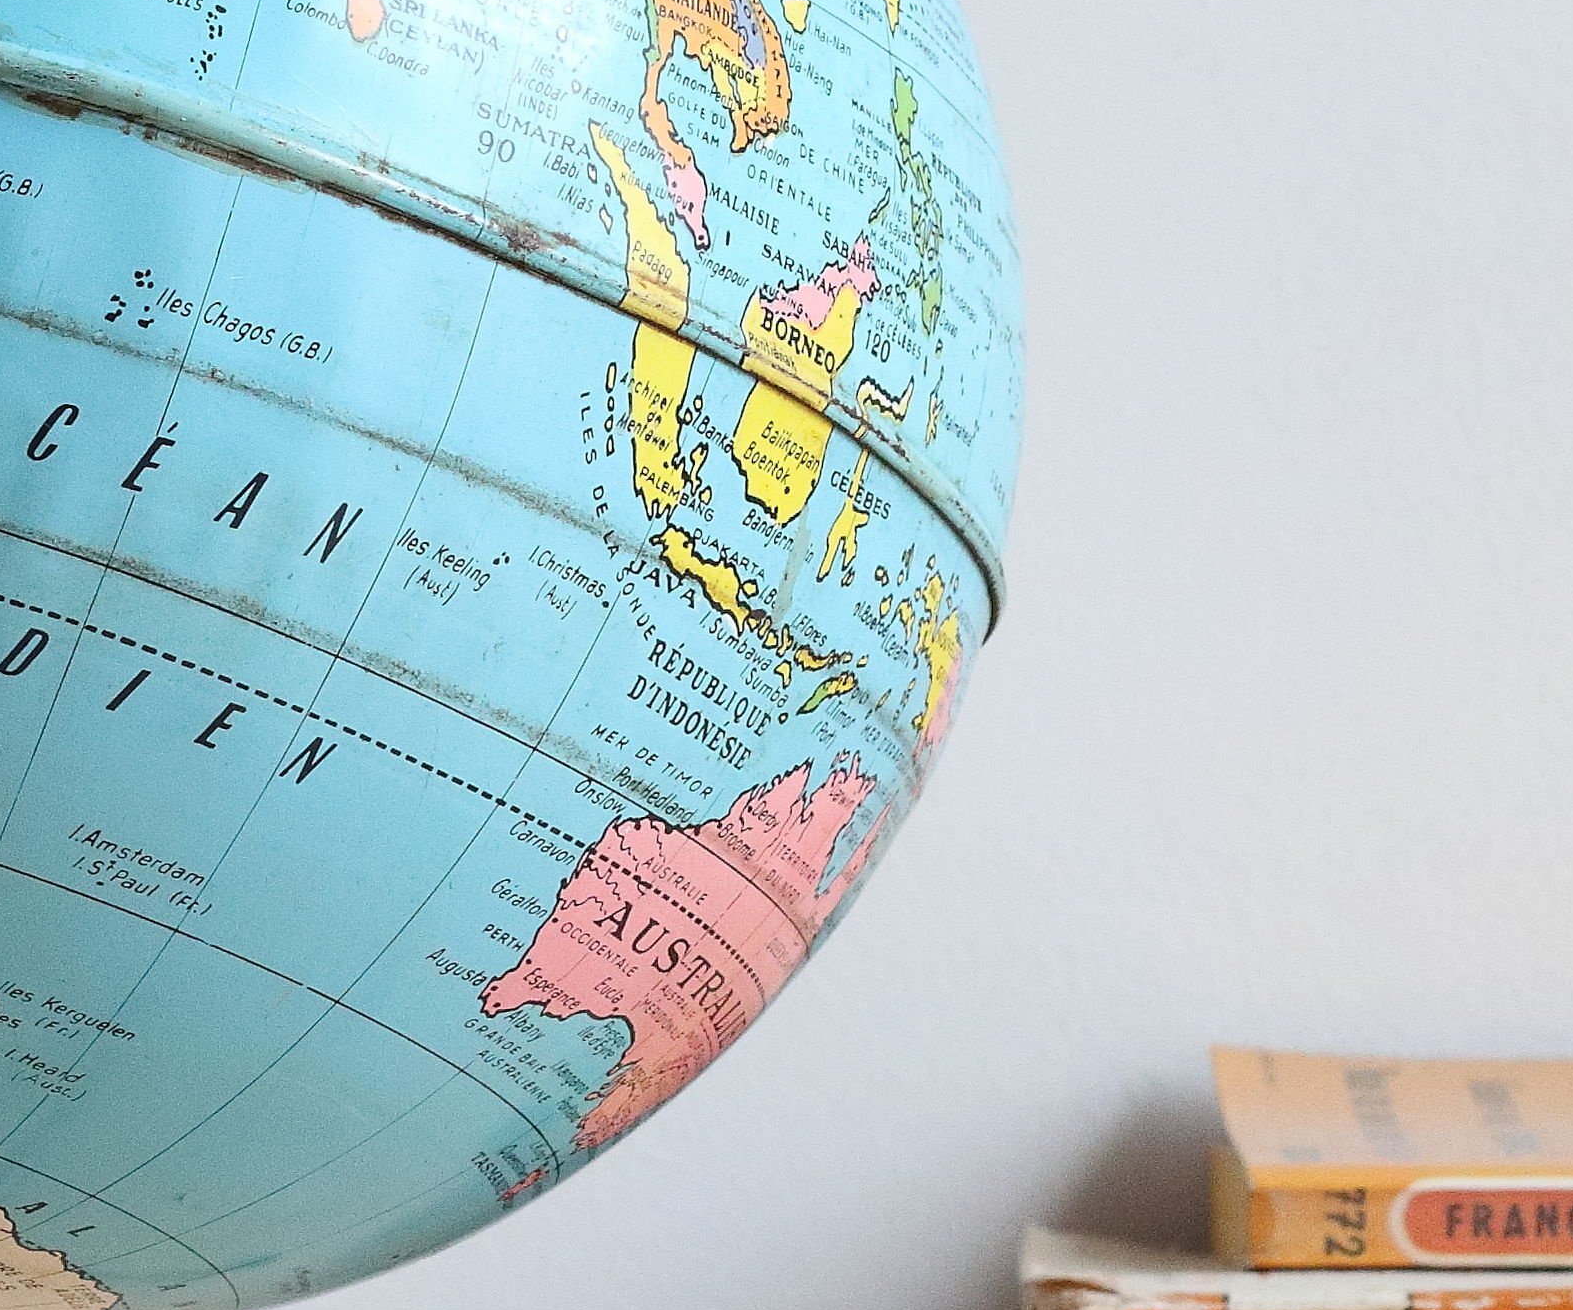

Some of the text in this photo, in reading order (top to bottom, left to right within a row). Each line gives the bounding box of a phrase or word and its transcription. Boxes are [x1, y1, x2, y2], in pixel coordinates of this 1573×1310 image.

[700, 43, 759, 88] CAMBODGE
[477, 103, 592, 159] SUMATRA
[477, 131, 515, 163] 90
[753, 137, 791, 168] Cholon
[710, 181, 781, 235] MALAISIE
[747, 164, 832, 221] ORIENTALE
[761, 248, 837, 296] SARAWAK
[202, 302, 275, 347] Chagos
[761, 311, 836, 375] BORNEO
[865, 330, 891, 363] 120
[639, 466, 714, 523] PALEMBANG
[432, 543, 491, 590] Keeling
[692, 528, 765, 576] DJAKARTA
[629, 560, 697, 607] JAVA
[648, 637, 773, 737] RÉPUBLIQUE
[628, 676, 752, 770] D'INDONÉSIE
[591, 723, 713, 798] MER DE TIMOR
[574, 779, 625, 815] Onslow
[482, 923, 522, 951] PERTH
[561, 921, 636, 978] OCCIDENTALE
[426, 946, 488, 985] Augusta
[42, 996, 136, 1043] Kerguelen
[505, 1010, 546, 1041] Albany
[1323, 1188, 1367, 1257] 772
